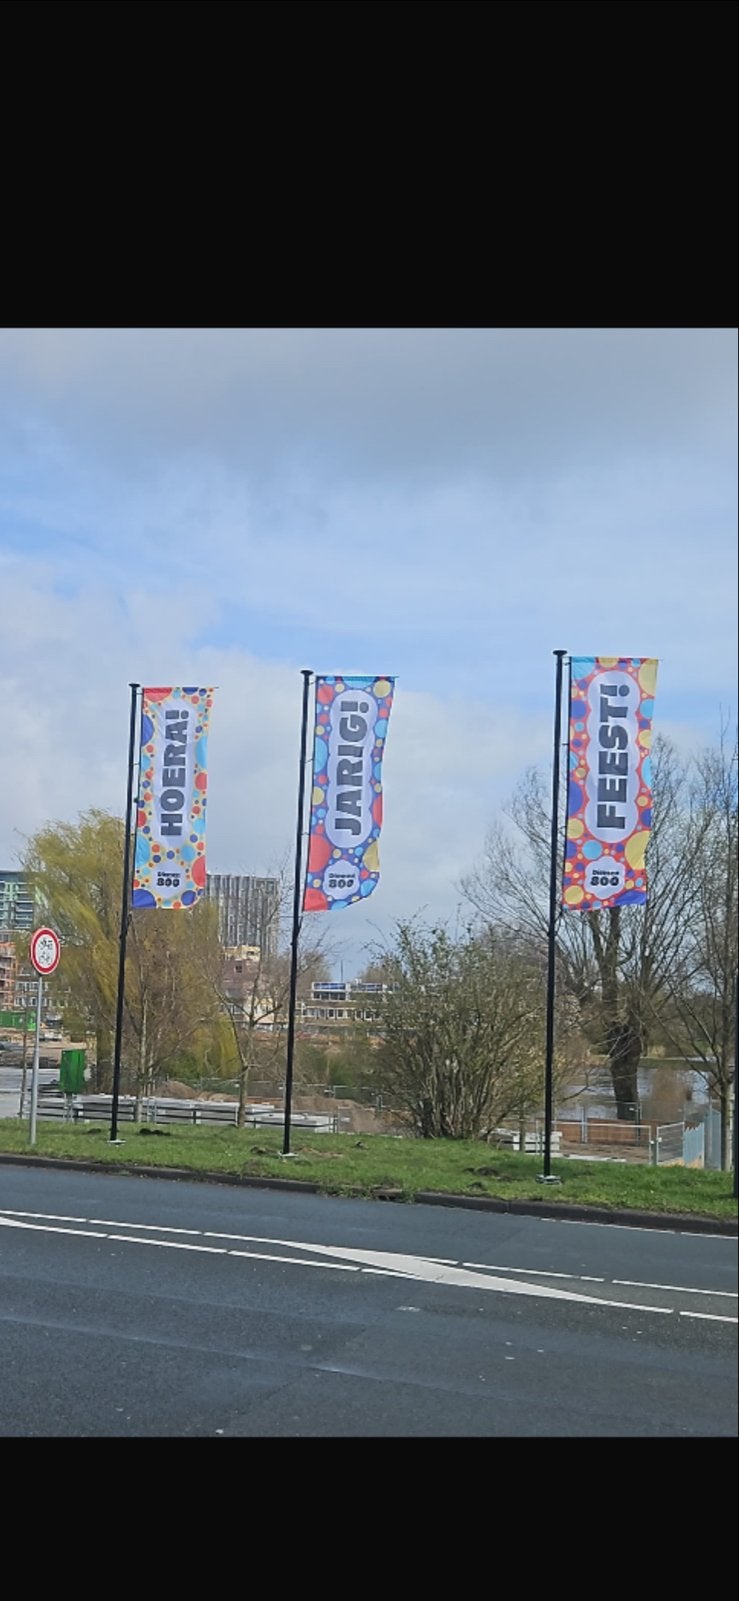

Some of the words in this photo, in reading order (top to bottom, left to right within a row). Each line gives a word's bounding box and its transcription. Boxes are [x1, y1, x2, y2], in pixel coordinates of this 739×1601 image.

[160, 709, 189, 836] HOERA!
[335, 701, 369, 836] JARIG!
[597, 684, 630, 830] FEEST!
[157, 877, 180, 887] 800
[328, 879, 354, 888] 800
[590, 875, 619, 886] 800
